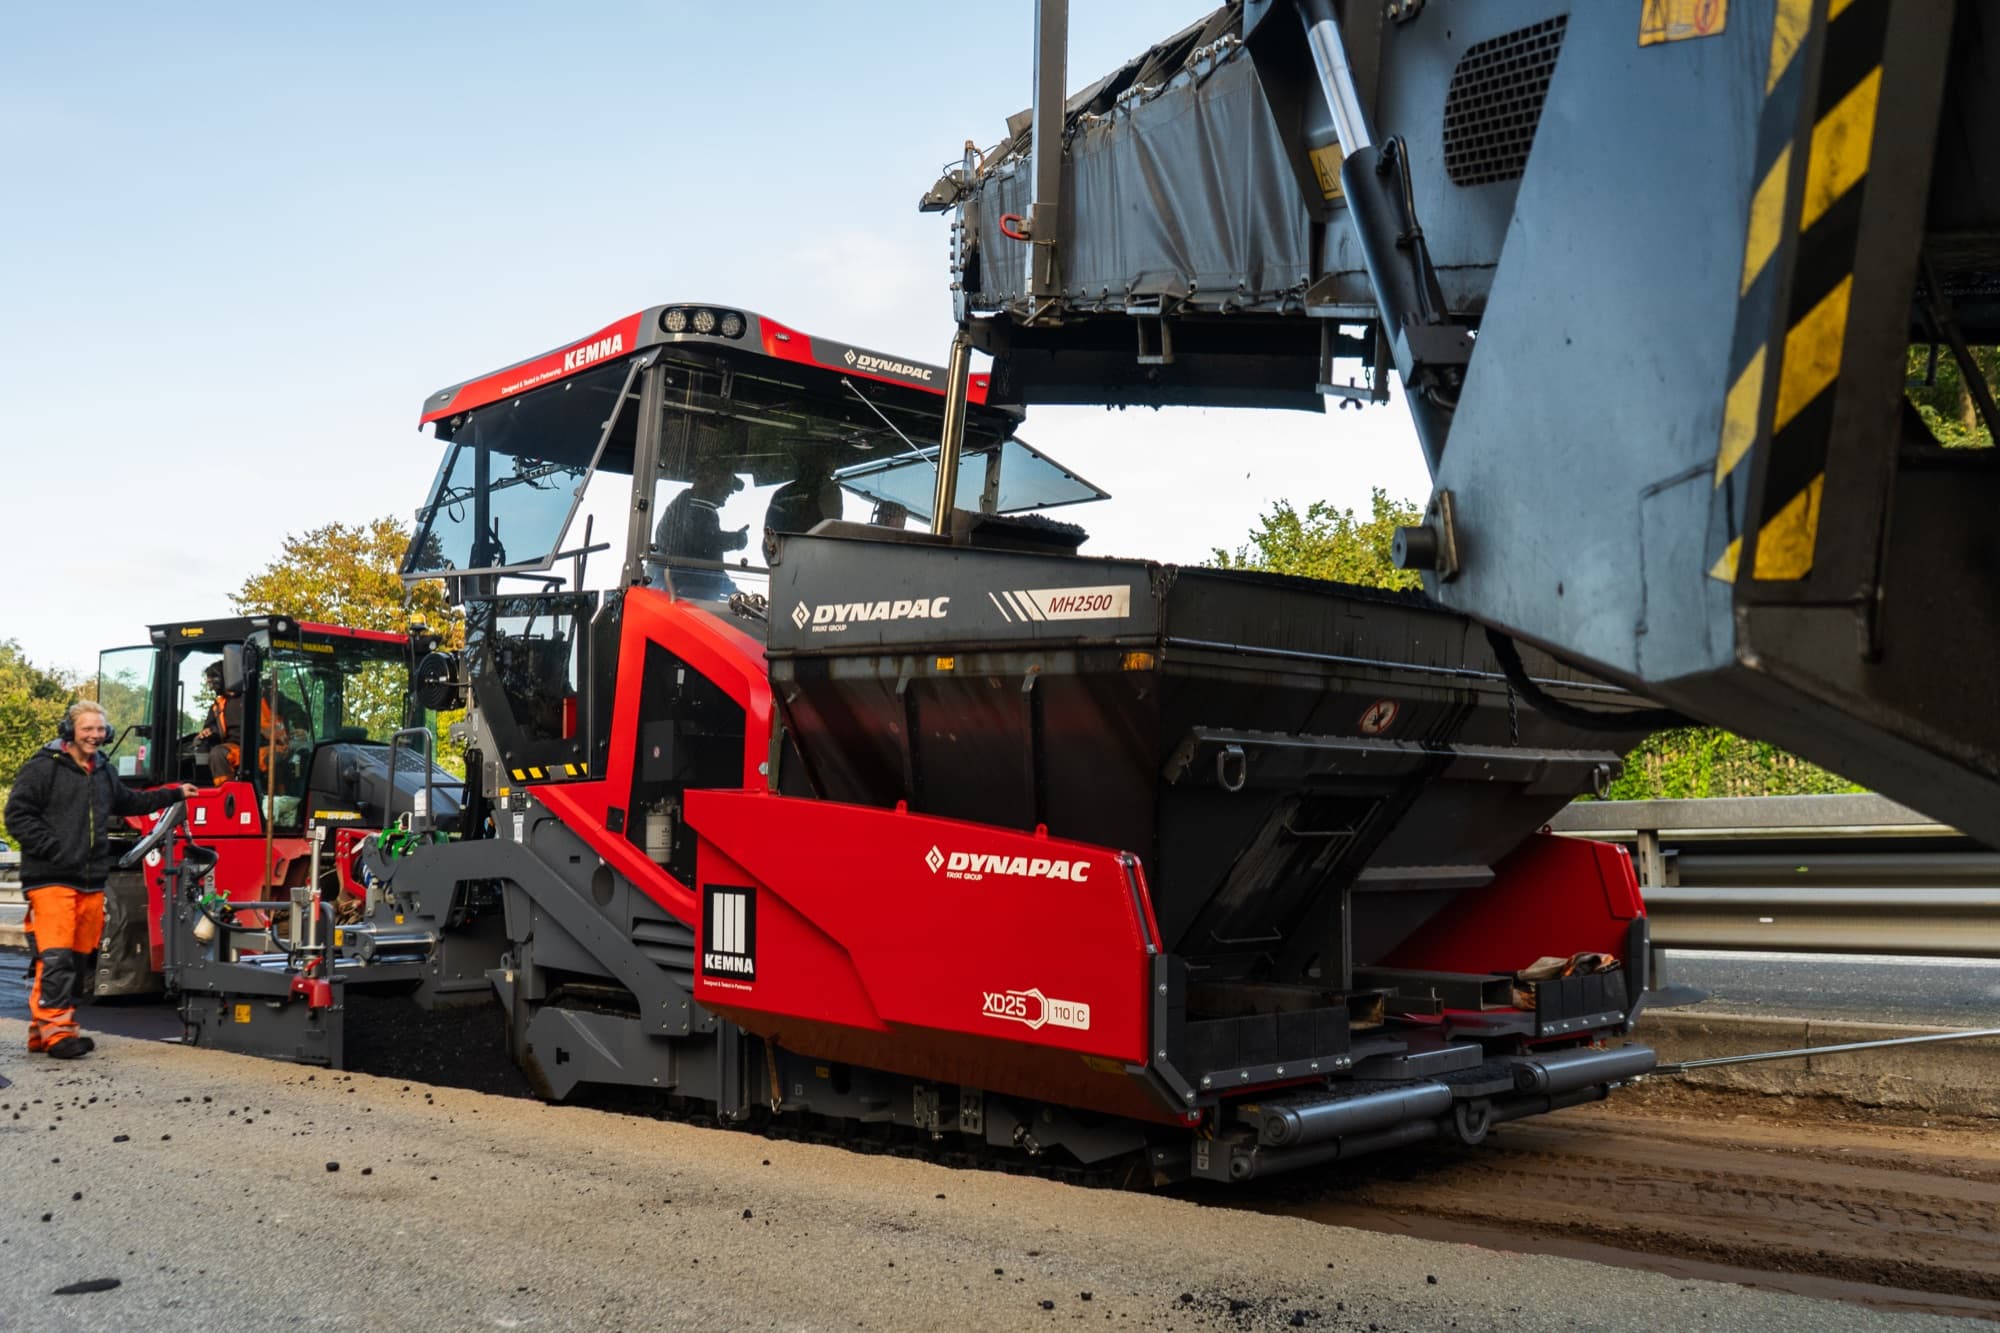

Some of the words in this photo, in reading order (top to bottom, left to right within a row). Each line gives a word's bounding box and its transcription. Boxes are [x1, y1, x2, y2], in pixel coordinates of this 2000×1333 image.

[564, 333, 623, 371] KEMNA
[857, 354, 932, 381] DYNAPAC
[812, 597, 950, 624] DYNAPAC
[1048, 594, 1113, 613] MH2500
[947, 851, 1091, 882] DYNAPAC
[963, 873, 983, 881] GROUP
[704, 953, 754, 974] KEMNA
[982, 991, 1027, 1017] XD25
[1054, 1006, 1071, 1020] 110
[1077, 1009, 1086, 1023] C
